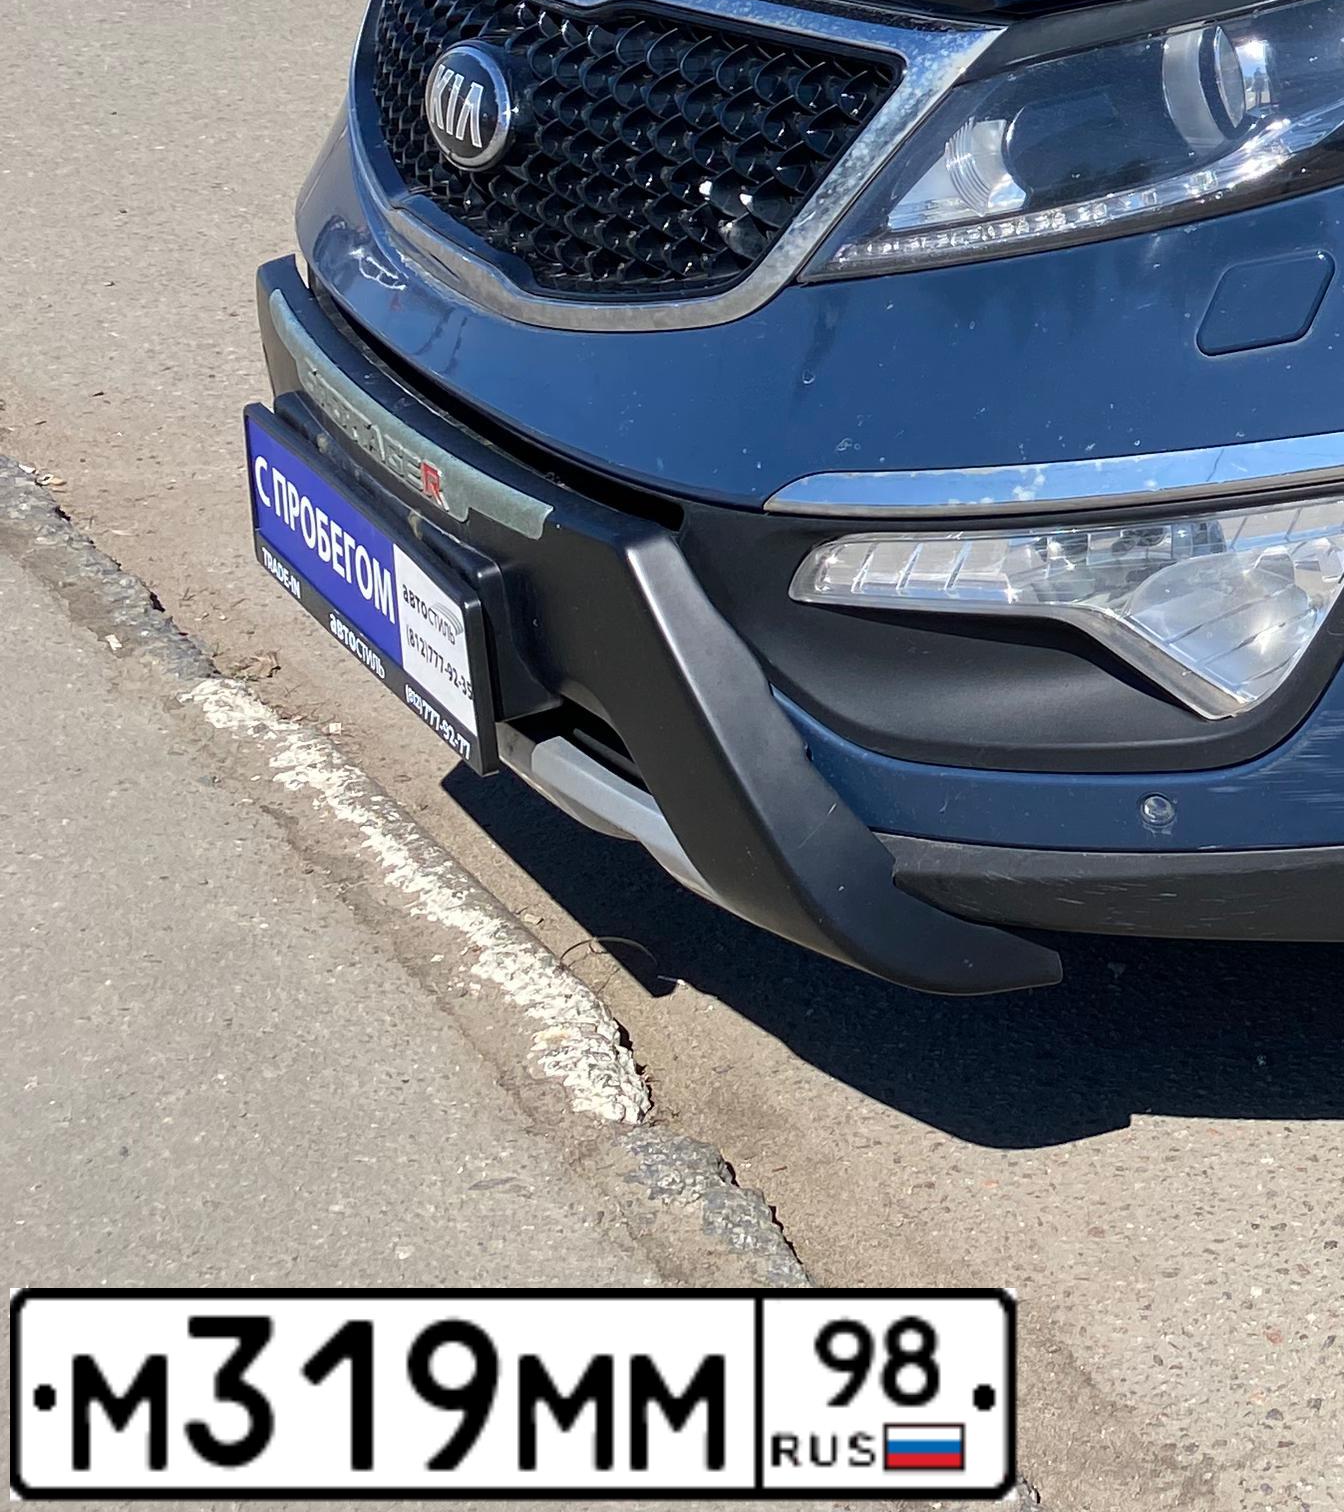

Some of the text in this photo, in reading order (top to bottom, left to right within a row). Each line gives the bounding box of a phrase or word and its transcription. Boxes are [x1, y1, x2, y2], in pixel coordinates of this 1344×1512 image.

[430, 64, 485, 148] KIA
[254, 455, 396, 624] С ПРОБЕГОМ
[261, 547, 301, 599] TRADE-IN
